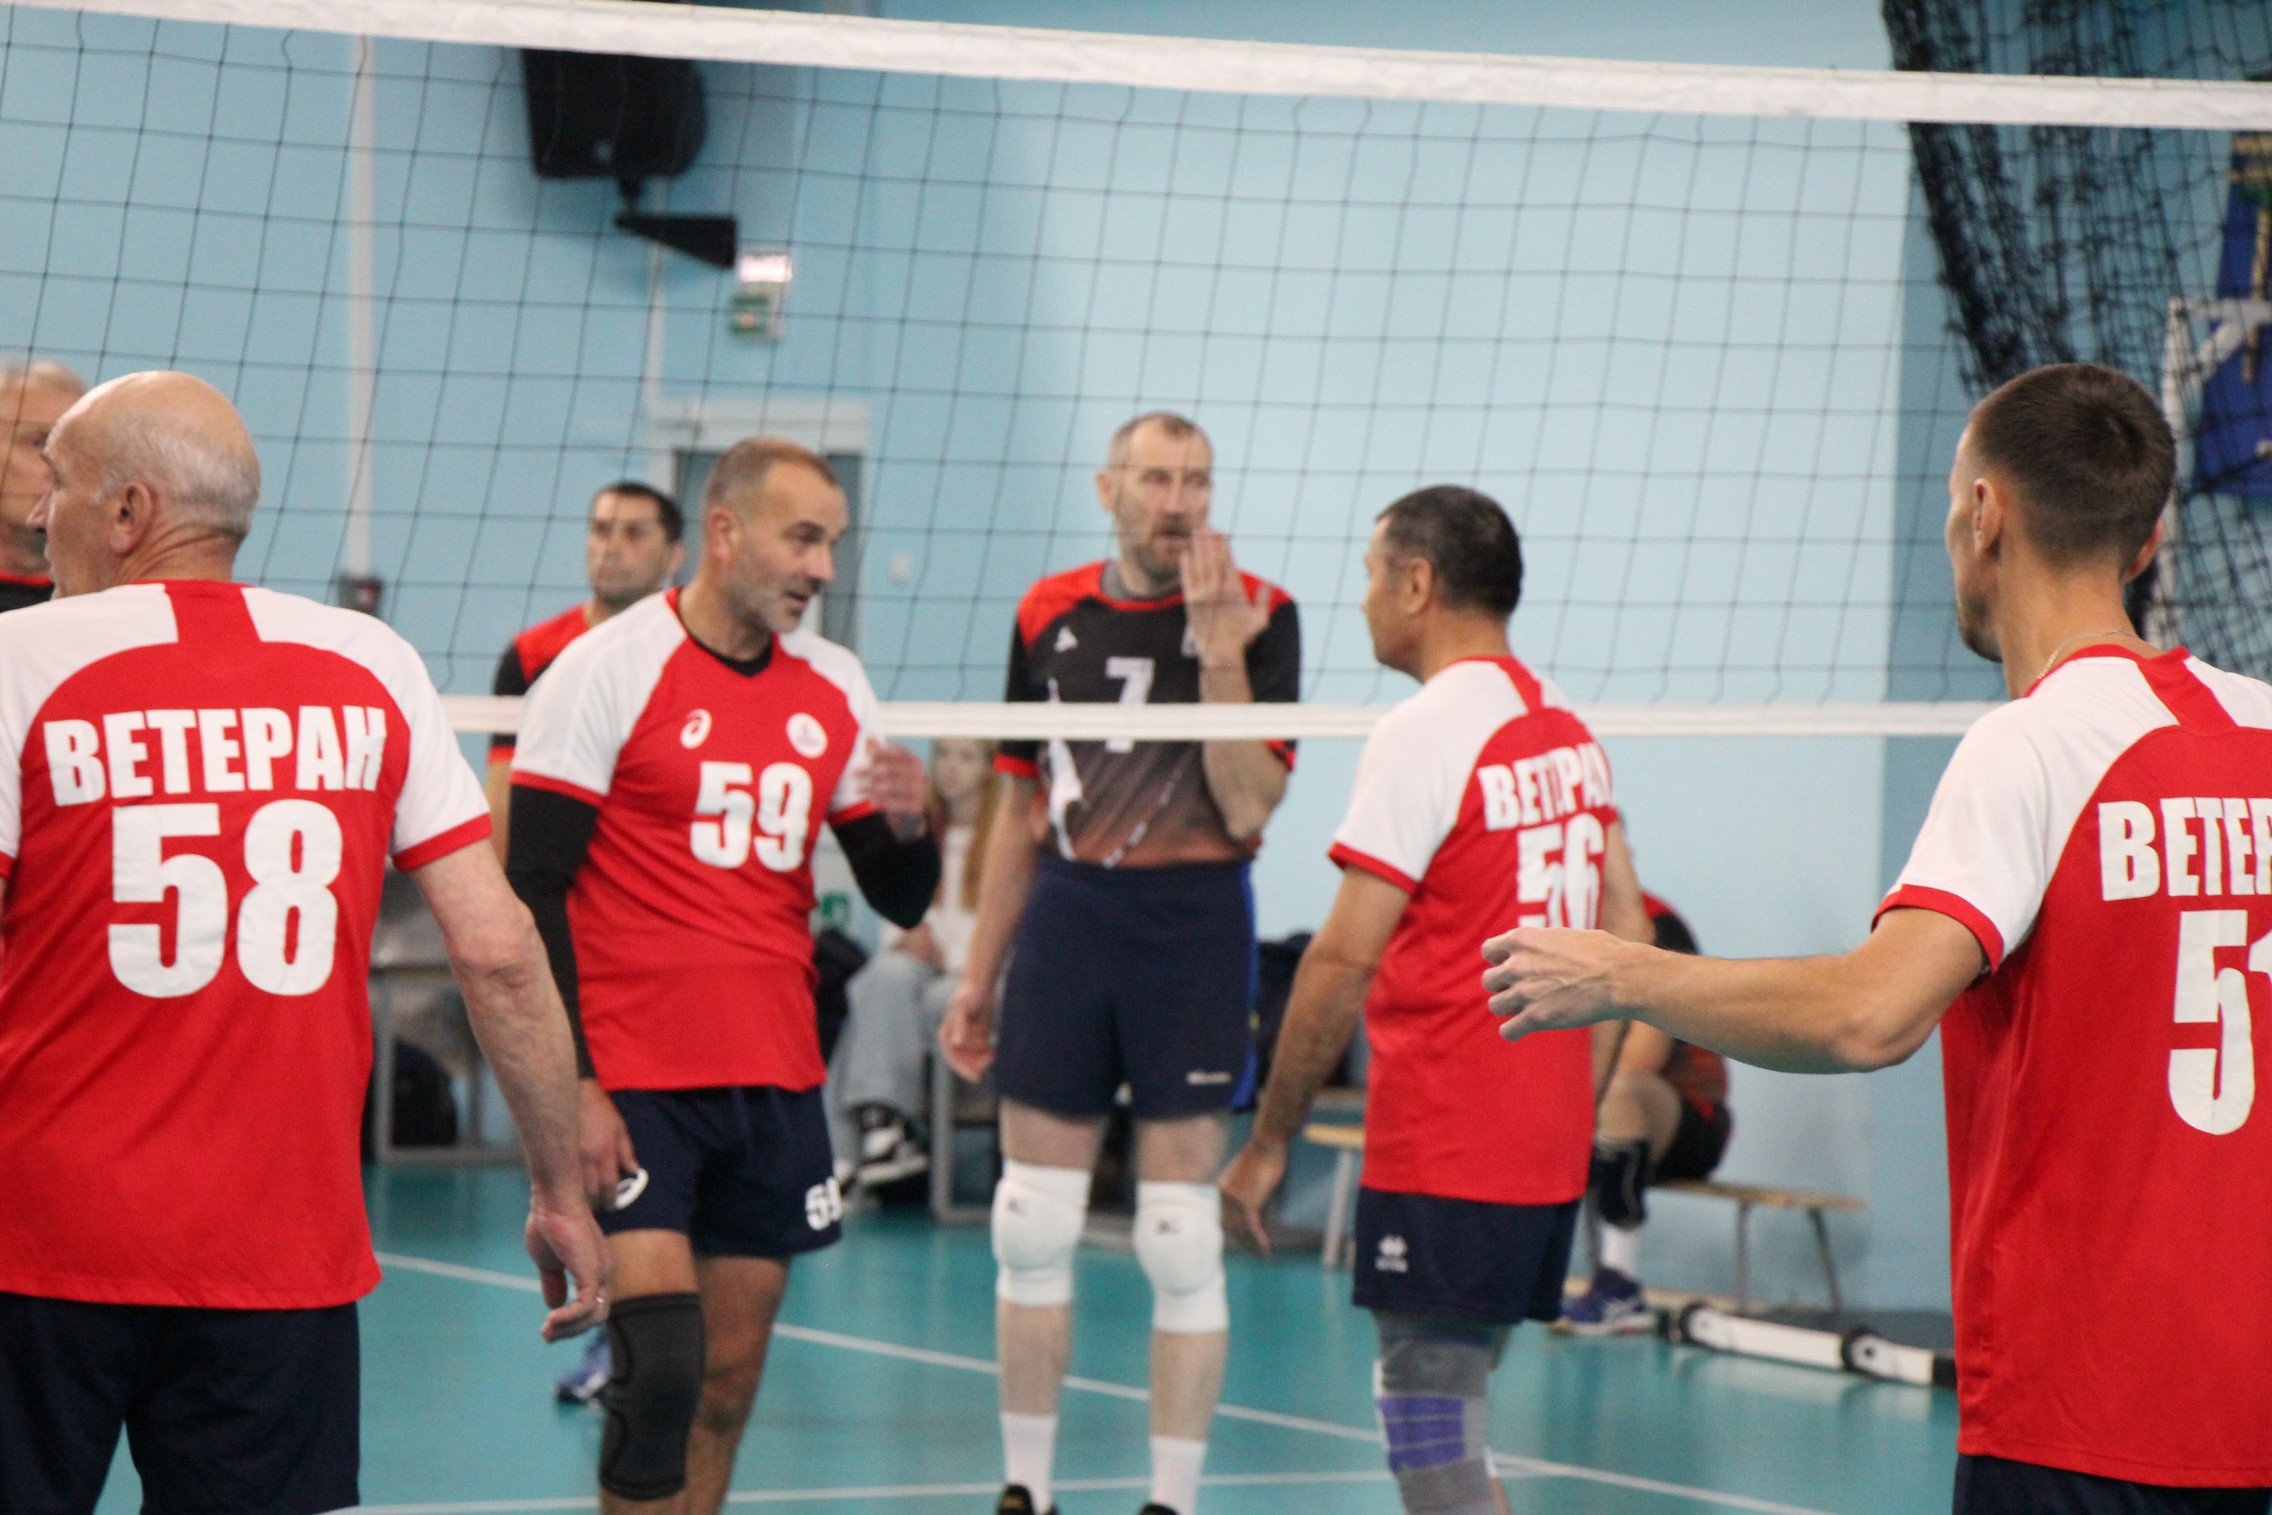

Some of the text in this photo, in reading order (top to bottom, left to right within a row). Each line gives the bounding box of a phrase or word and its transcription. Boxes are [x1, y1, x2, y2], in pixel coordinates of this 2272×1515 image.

[44, 705, 387, 806] ВЕТЕРАН
[1106, 656, 1155, 752] 7
[690, 761, 813, 872] 59
[1517, 812, 1604, 929] 56
[108, 799, 343, 998] 58
